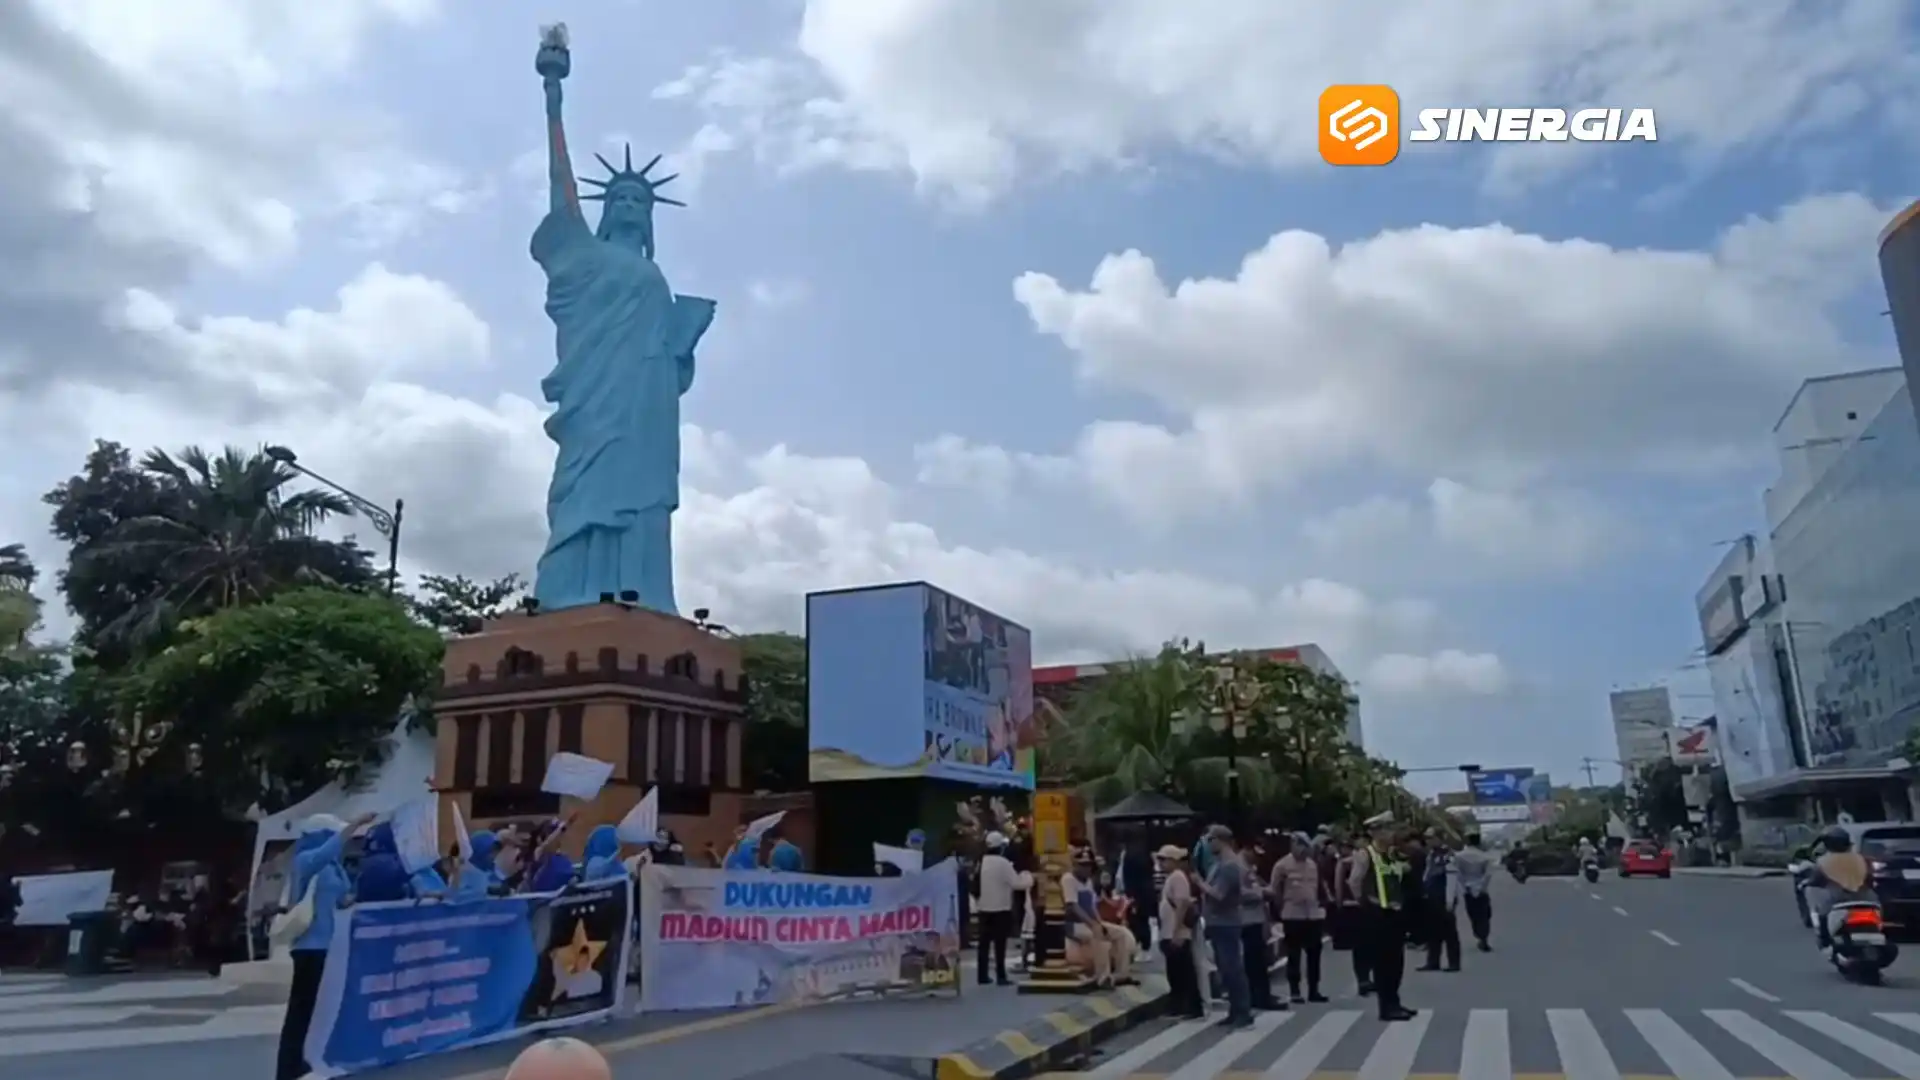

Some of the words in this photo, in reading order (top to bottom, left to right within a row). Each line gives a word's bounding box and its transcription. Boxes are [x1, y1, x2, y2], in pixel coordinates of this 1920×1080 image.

[724, 881, 872, 908] DUKUNGAN
[659, 913, 769, 941] MADIUN
[775, 916, 853, 942] CINTA
[858, 905, 931, 937] MAIDI
